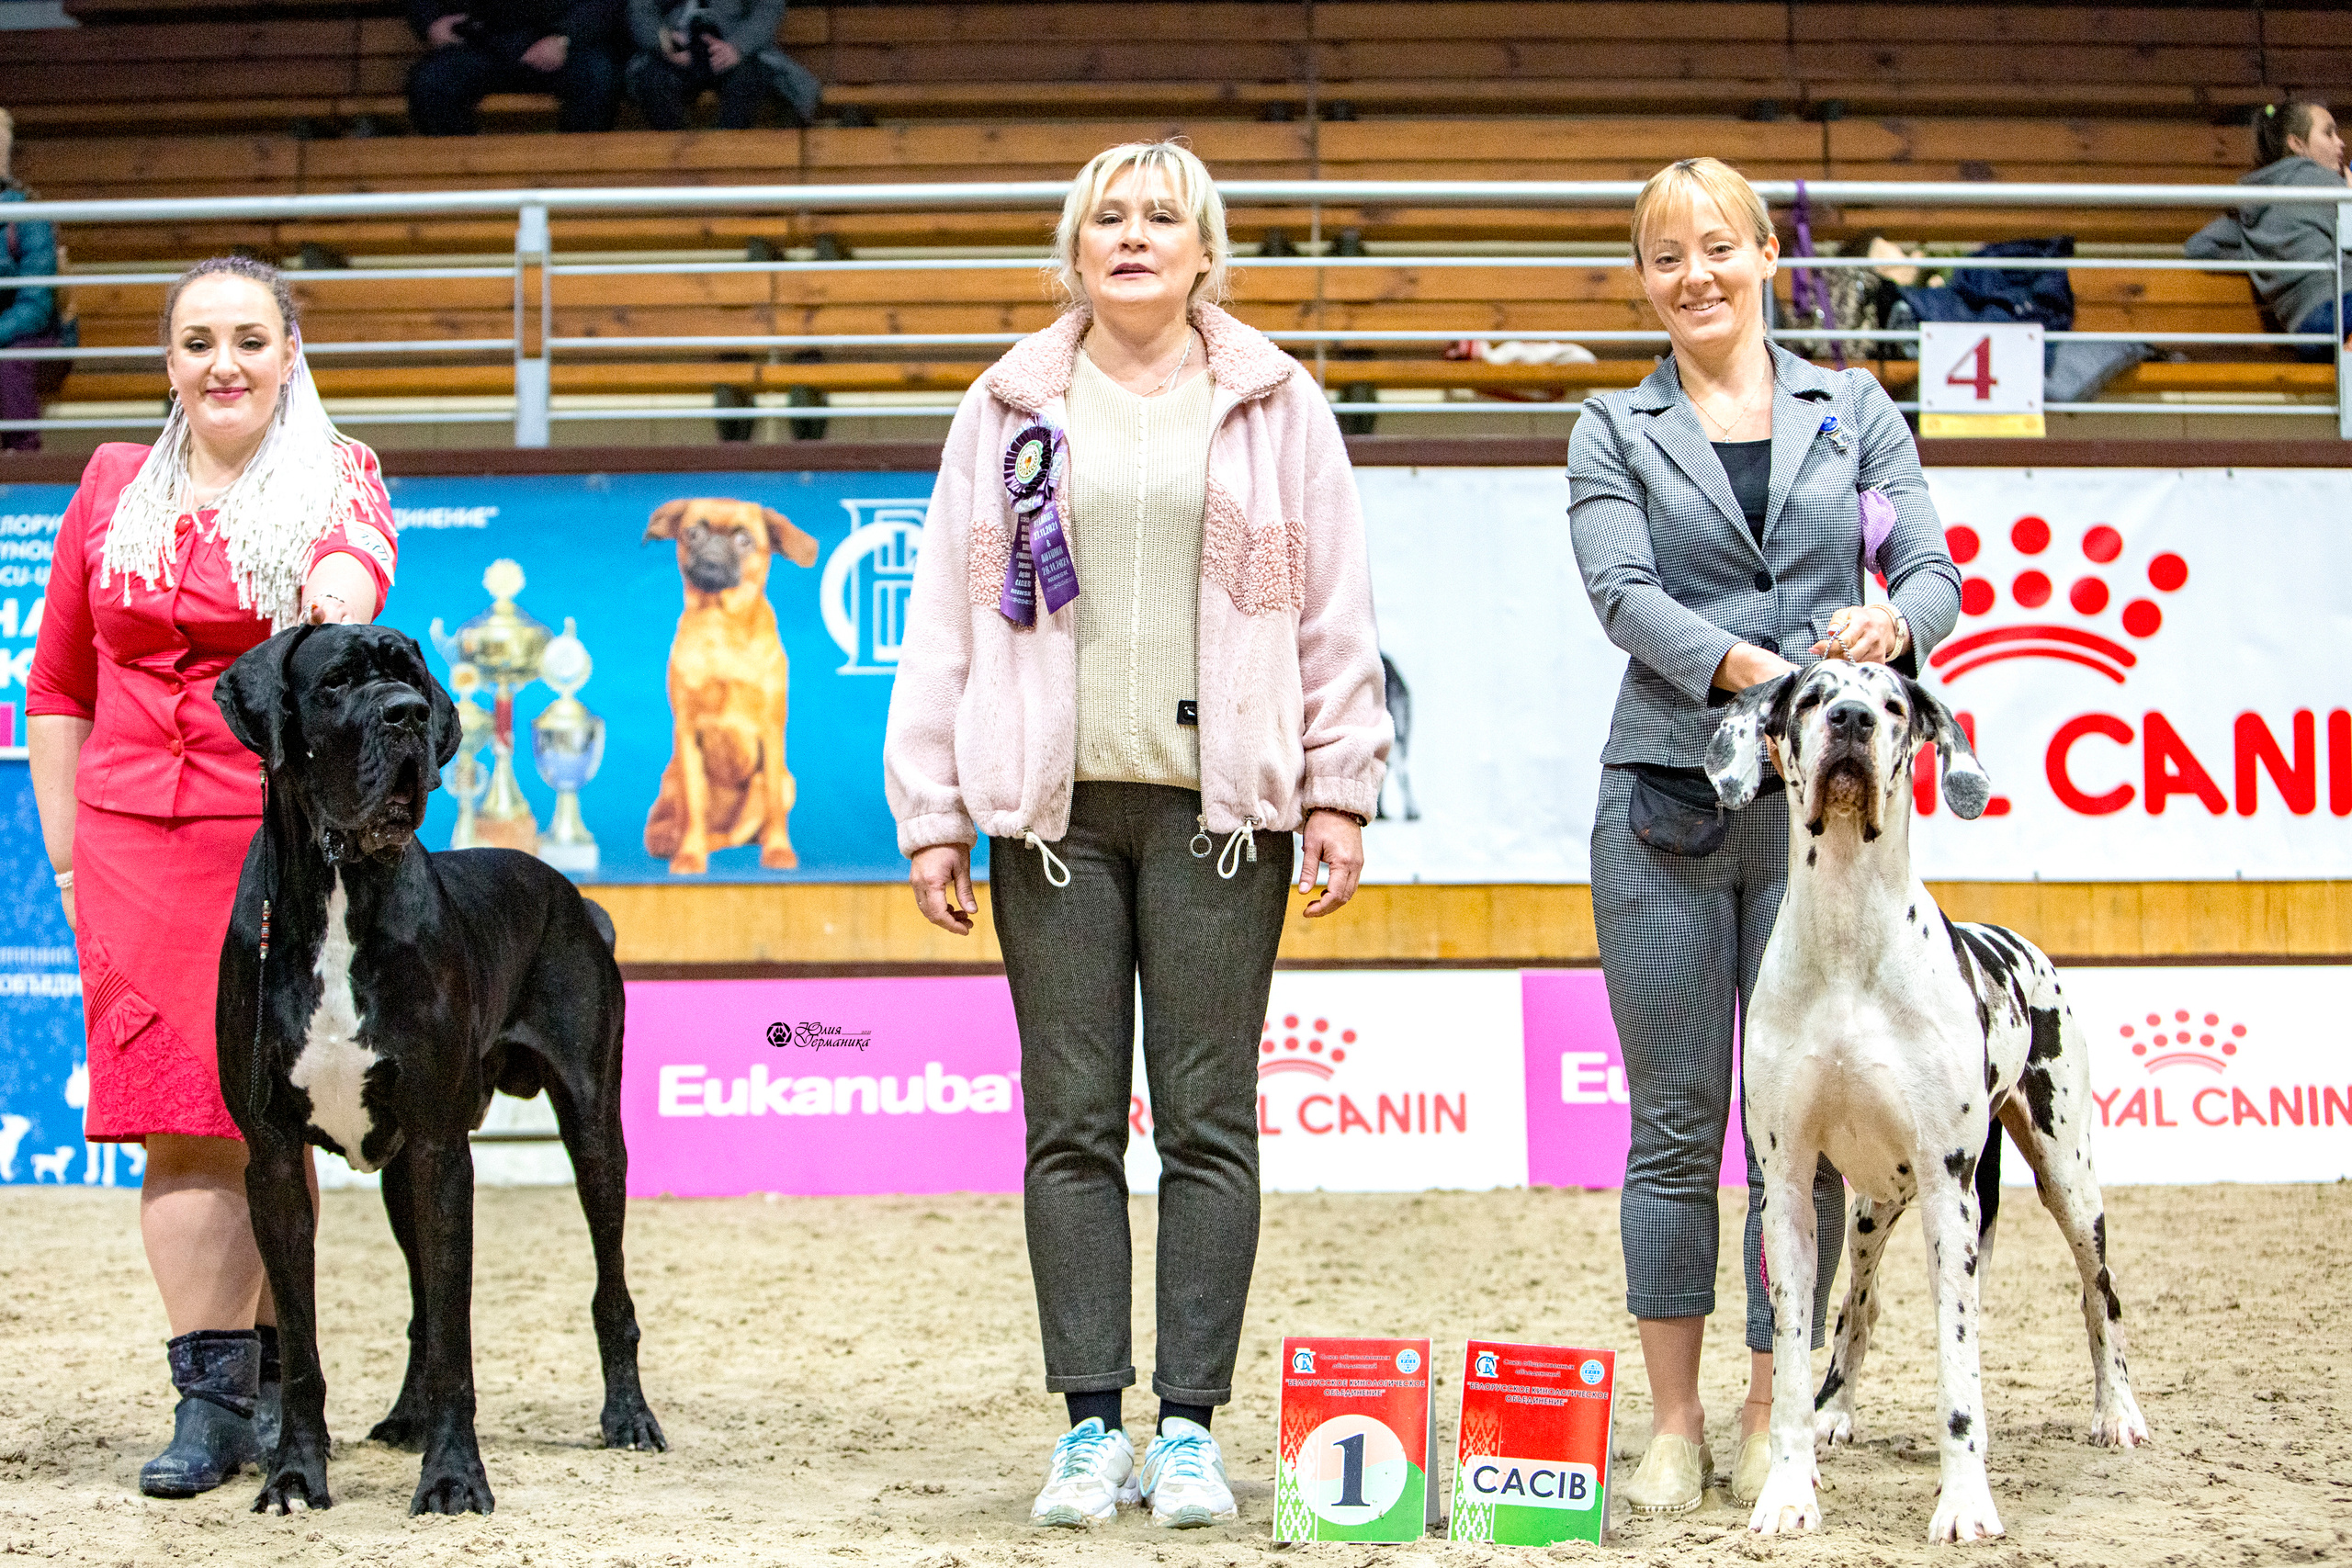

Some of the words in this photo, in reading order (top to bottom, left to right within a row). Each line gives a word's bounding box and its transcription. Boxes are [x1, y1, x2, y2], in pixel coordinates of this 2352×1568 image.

[1946, 334, 1998, 400] 4
[1033, 520, 1058, 541] 27.11.2021
[1046, 538, 1051, 547] &
[1041, 556, 1069, 576] 28.11.2021
[2045, 707, 2352, 818] CANI
[659, 1061, 1012, 1117] Eukanuba
[1296, 1091, 1468, 1135] CANIN
[1349, 1379, 1425, 1388] КИНОЛОГИЧЕСКОЕ
[1532, 1386, 1609, 1400] КИНОЛОГИЧЕСКОЕ
[1331, 1432, 1372, 1507] 1
[1473, 1464, 1588, 1500] CACIB
